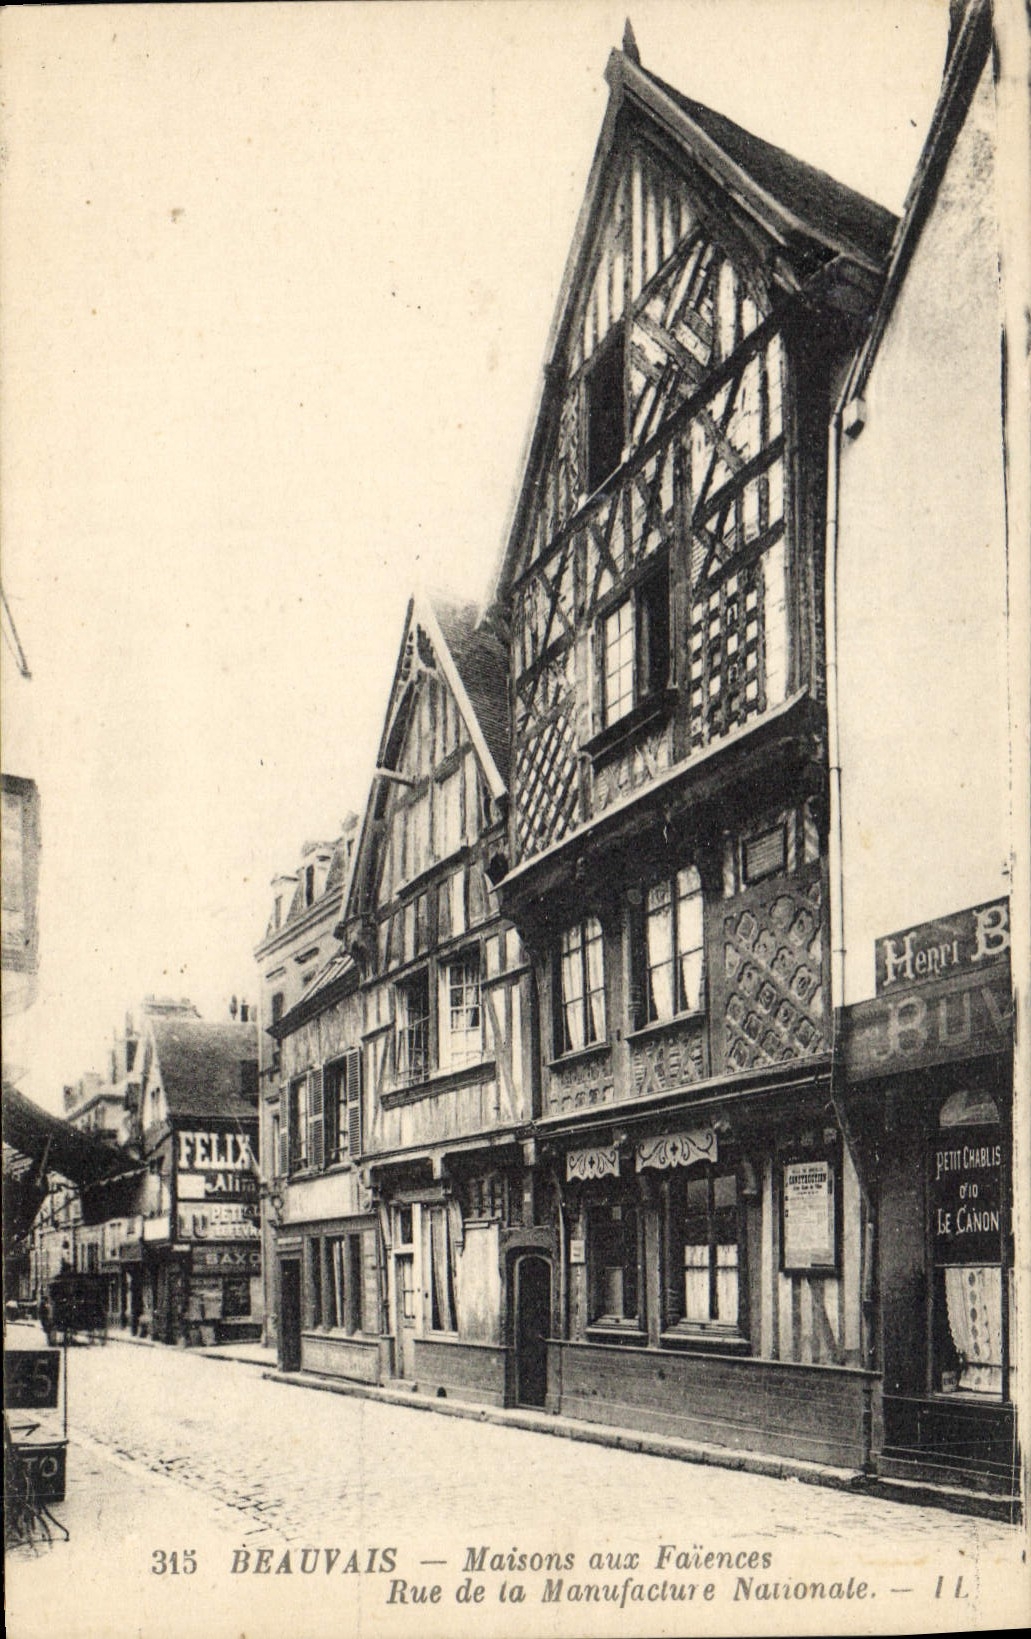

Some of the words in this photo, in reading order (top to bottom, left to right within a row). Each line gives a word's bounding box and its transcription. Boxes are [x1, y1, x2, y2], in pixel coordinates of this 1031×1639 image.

[883, 931, 960, 986] Henri
[971, 904, 1010, 961] B
[178, 1131, 250, 1170] FELIX
[936, 1150, 961, 1180] PETIT
[963, 1145, 1001, 1169] CHABLIS
